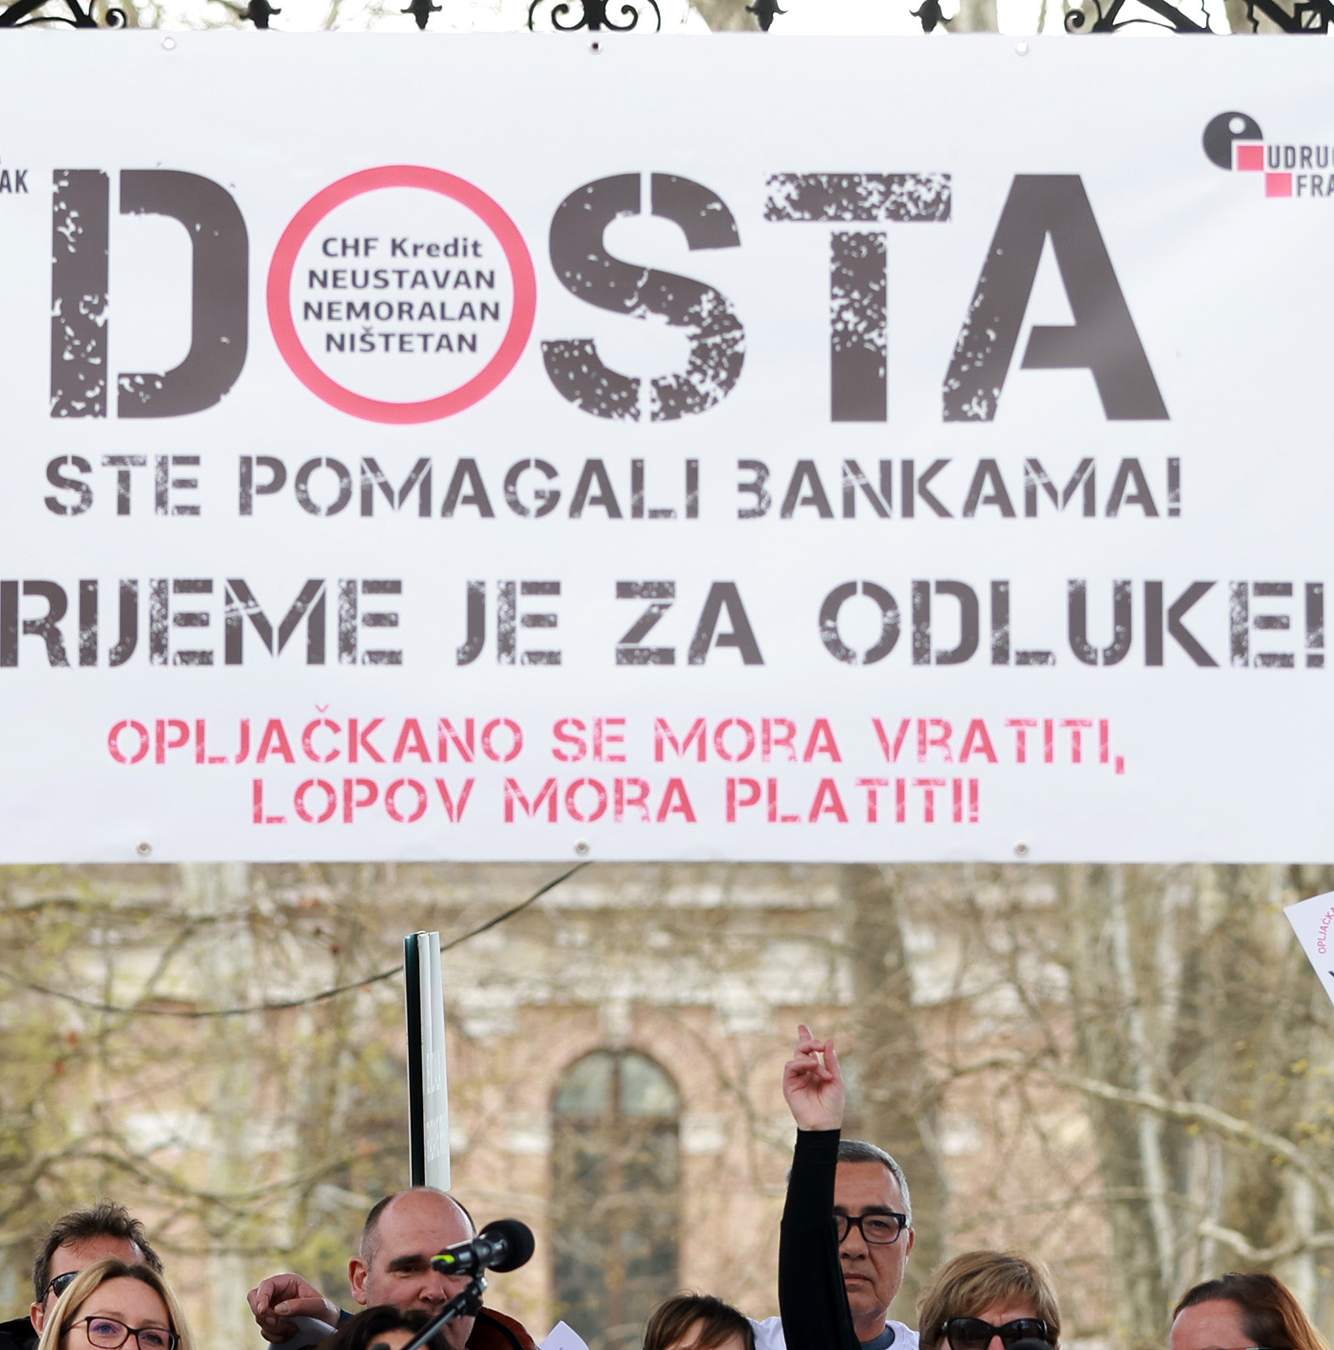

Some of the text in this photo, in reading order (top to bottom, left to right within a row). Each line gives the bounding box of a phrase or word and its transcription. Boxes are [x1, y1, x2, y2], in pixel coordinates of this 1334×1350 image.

[321, 236, 484, 260] CHF Kredit
[307, 268, 497, 291] NEUSTAVAN
[303, 300, 501, 323] NEMORALAN
[325, 326, 479, 354] NIŠTETAN
[43, 455, 1182, 519] STE POMAGALI BANKAMA!
[456, 579, 562, 667] JE
[614, 579, 765, 667] ZA
[818, 580, 1326, 668] ODLUKE!
[107, 703, 1126, 776] OPLJAČKANO SE MORA VRATITI,
[251, 776, 981, 825] LOPOV MORA PLATITI!
